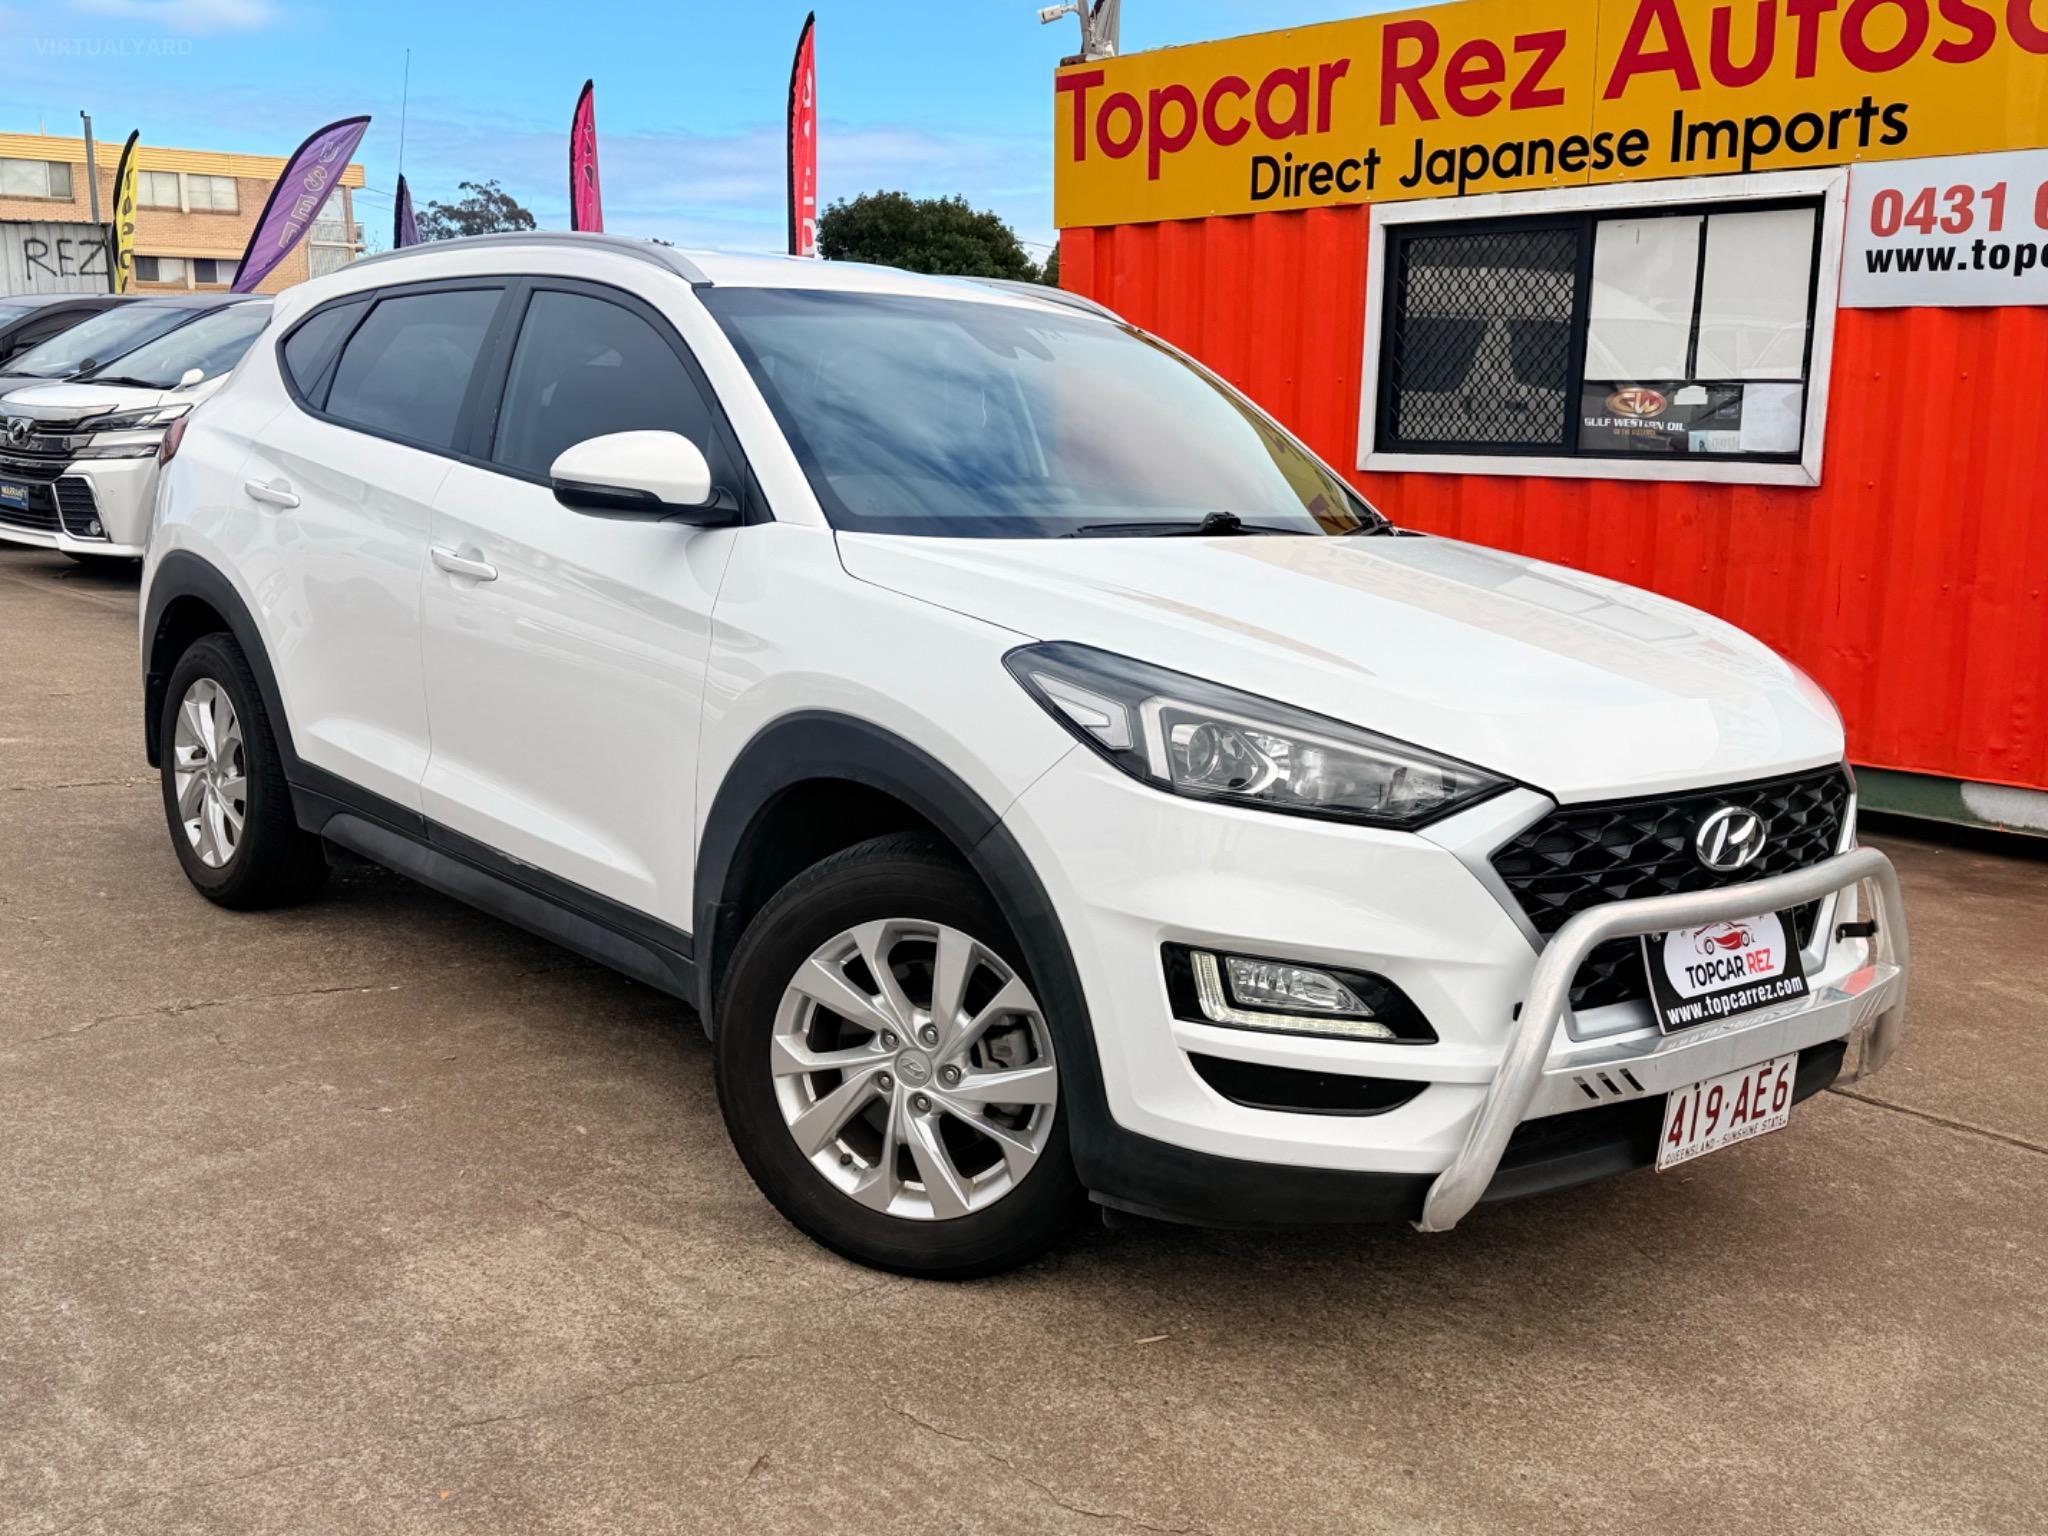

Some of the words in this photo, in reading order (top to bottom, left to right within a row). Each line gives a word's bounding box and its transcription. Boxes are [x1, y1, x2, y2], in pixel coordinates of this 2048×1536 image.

[1056, 59, 1350, 181] Topcar
[1379, 19, 1566, 126] Rez
[1250, 148, 1381, 201] Direct
[1399, 129, 1649, 196] Japanese
[1670, 97, 1909, 171] Imports
[1871, 182, 2007, 237] 0431
[24, 238, 109, 280] REZ
[1667, 422, 1686, 432] OIL
[1685, 955, 1746, 989] TOPCAR
[1746, 948, 1774, 974] REZ
[1666, 976, 1803, 1025] www.topcarrez.com
